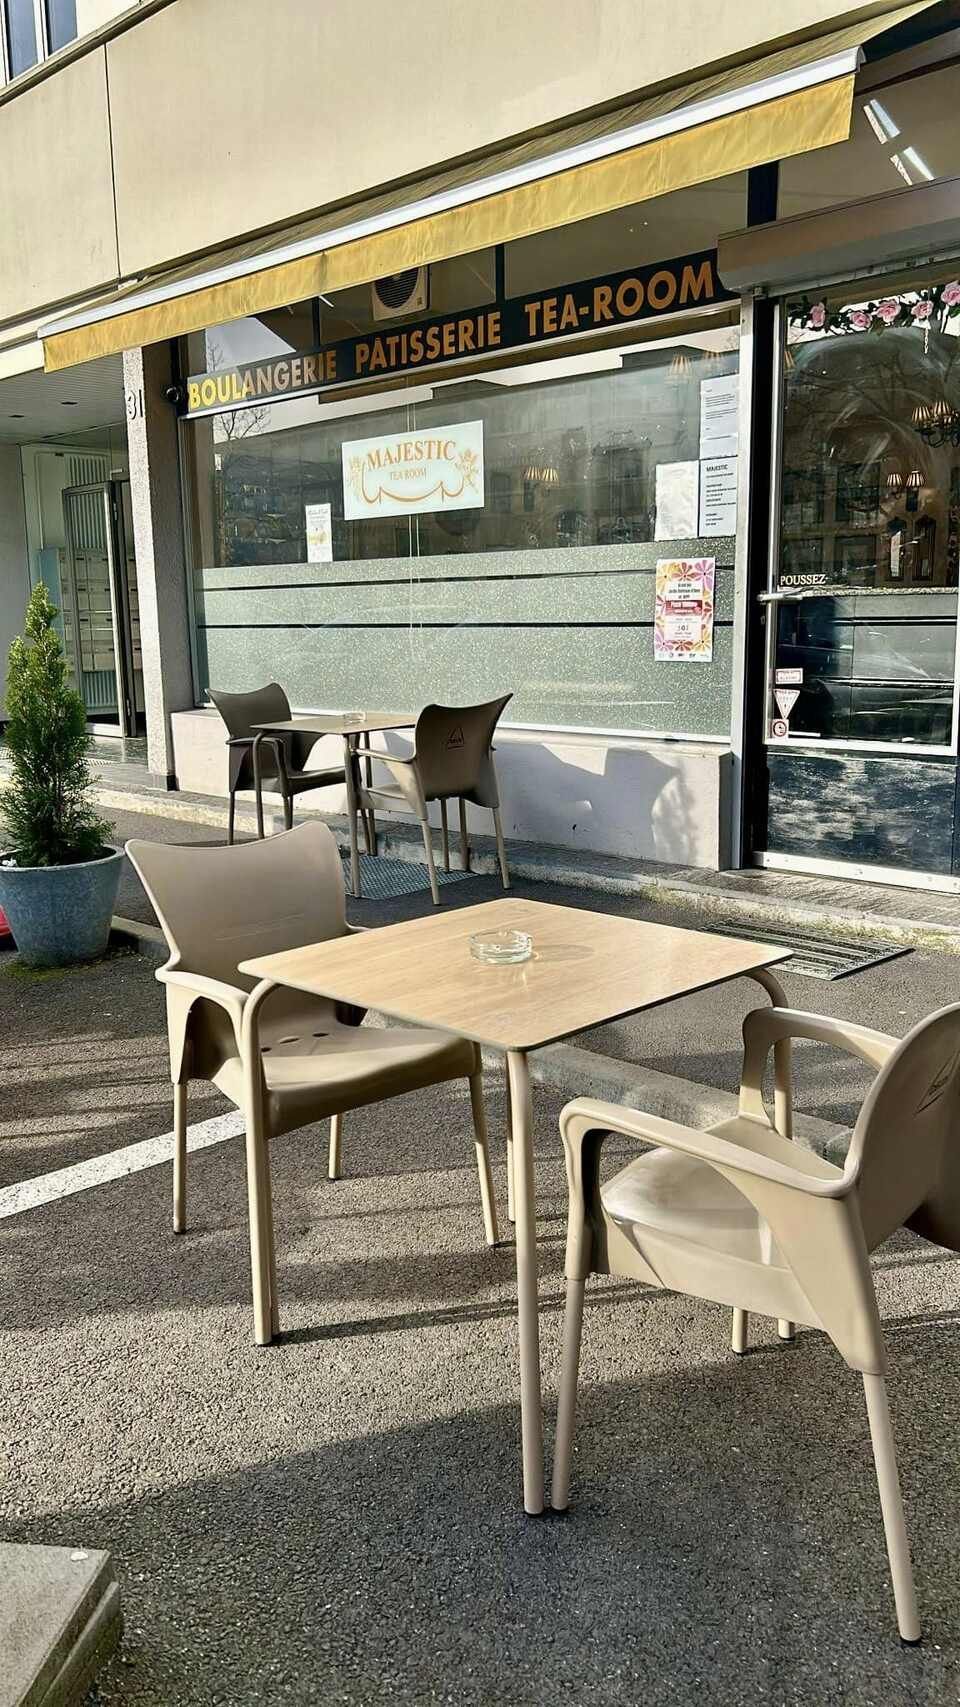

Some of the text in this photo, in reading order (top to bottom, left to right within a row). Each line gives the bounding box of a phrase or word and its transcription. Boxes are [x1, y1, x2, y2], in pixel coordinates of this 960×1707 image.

[188, 350, 337, 410] BOULANGERIE
[524, 261, 714, 337] TEA-ROOM
[127, 389, 143, 420] 31
[367, 439, 456, 470] MAJESTIC
[390, 467, 426, 481] TEA ROOM
[780, 574, 826, 586] POUSSEZ
